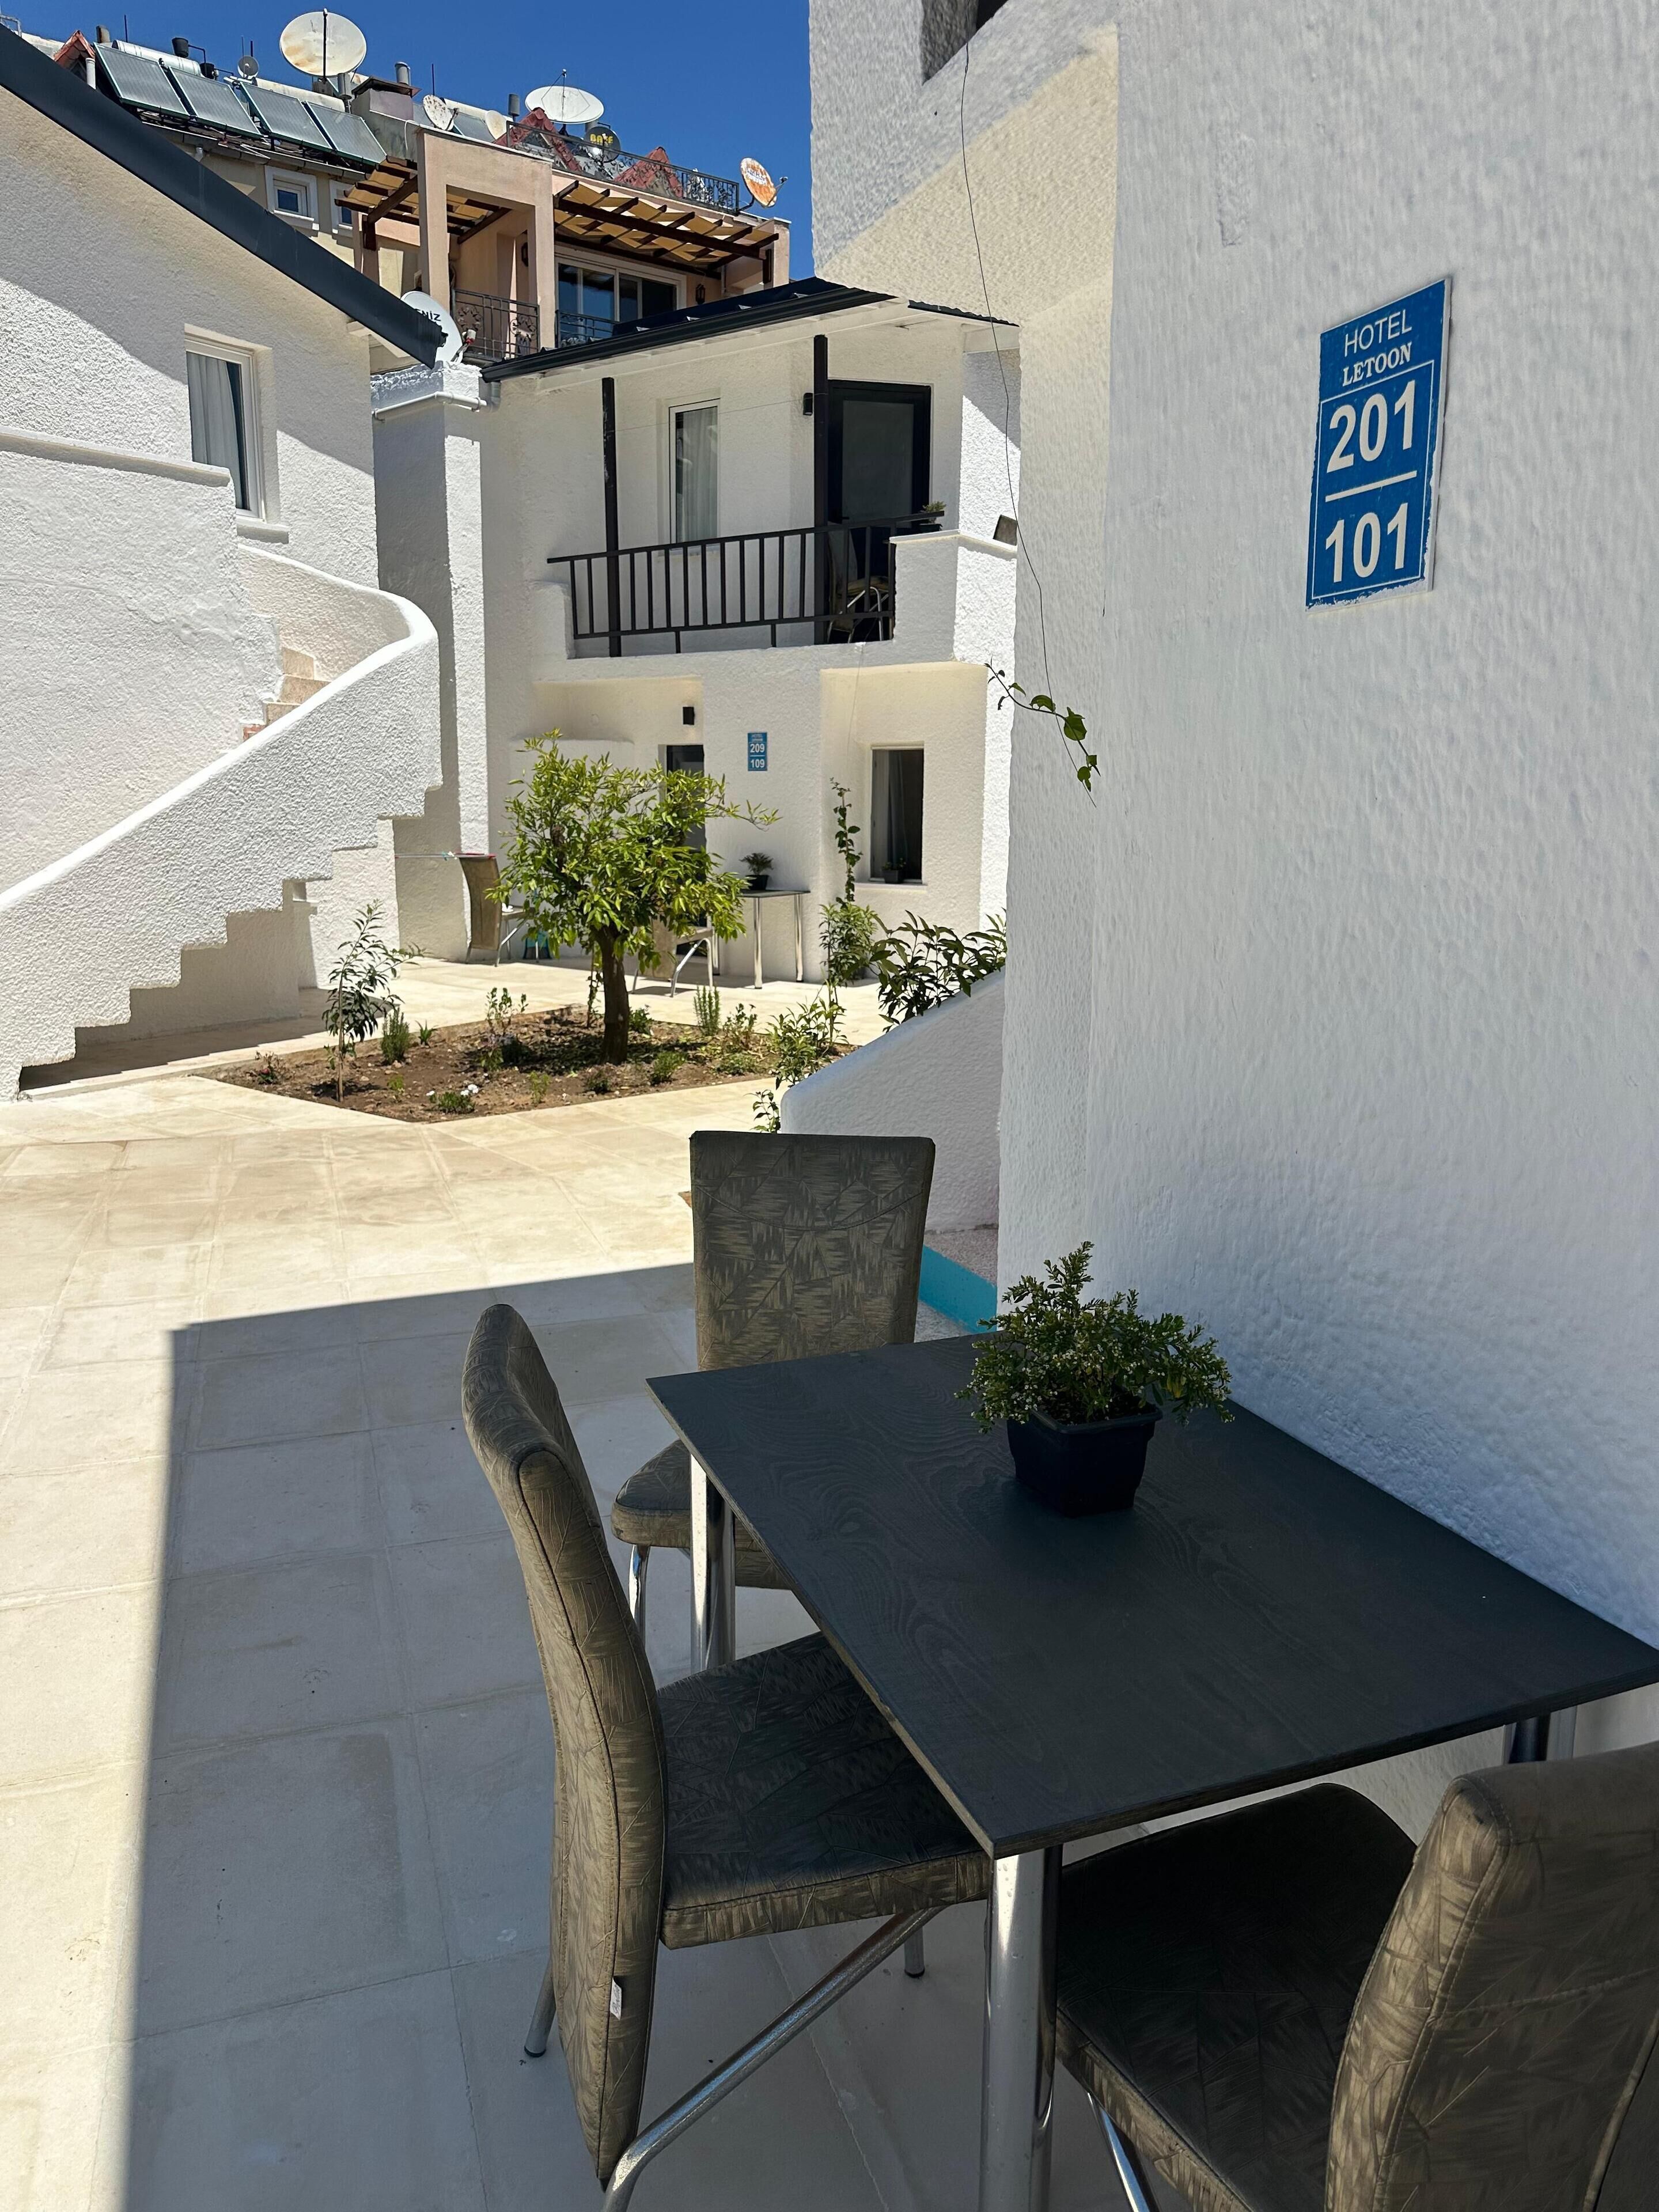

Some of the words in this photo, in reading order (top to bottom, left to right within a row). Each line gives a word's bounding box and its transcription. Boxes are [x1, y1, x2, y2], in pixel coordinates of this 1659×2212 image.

[1344, 309, 1412, 358] HOTEL
[1342, 341, 1412, 387] LETOON
[1326, 380, 1415, 474] 201
[1325, 502, 1408, 583] 101
[750, 743, 765, 753] 209
[751, 759, 765, 768] 109
